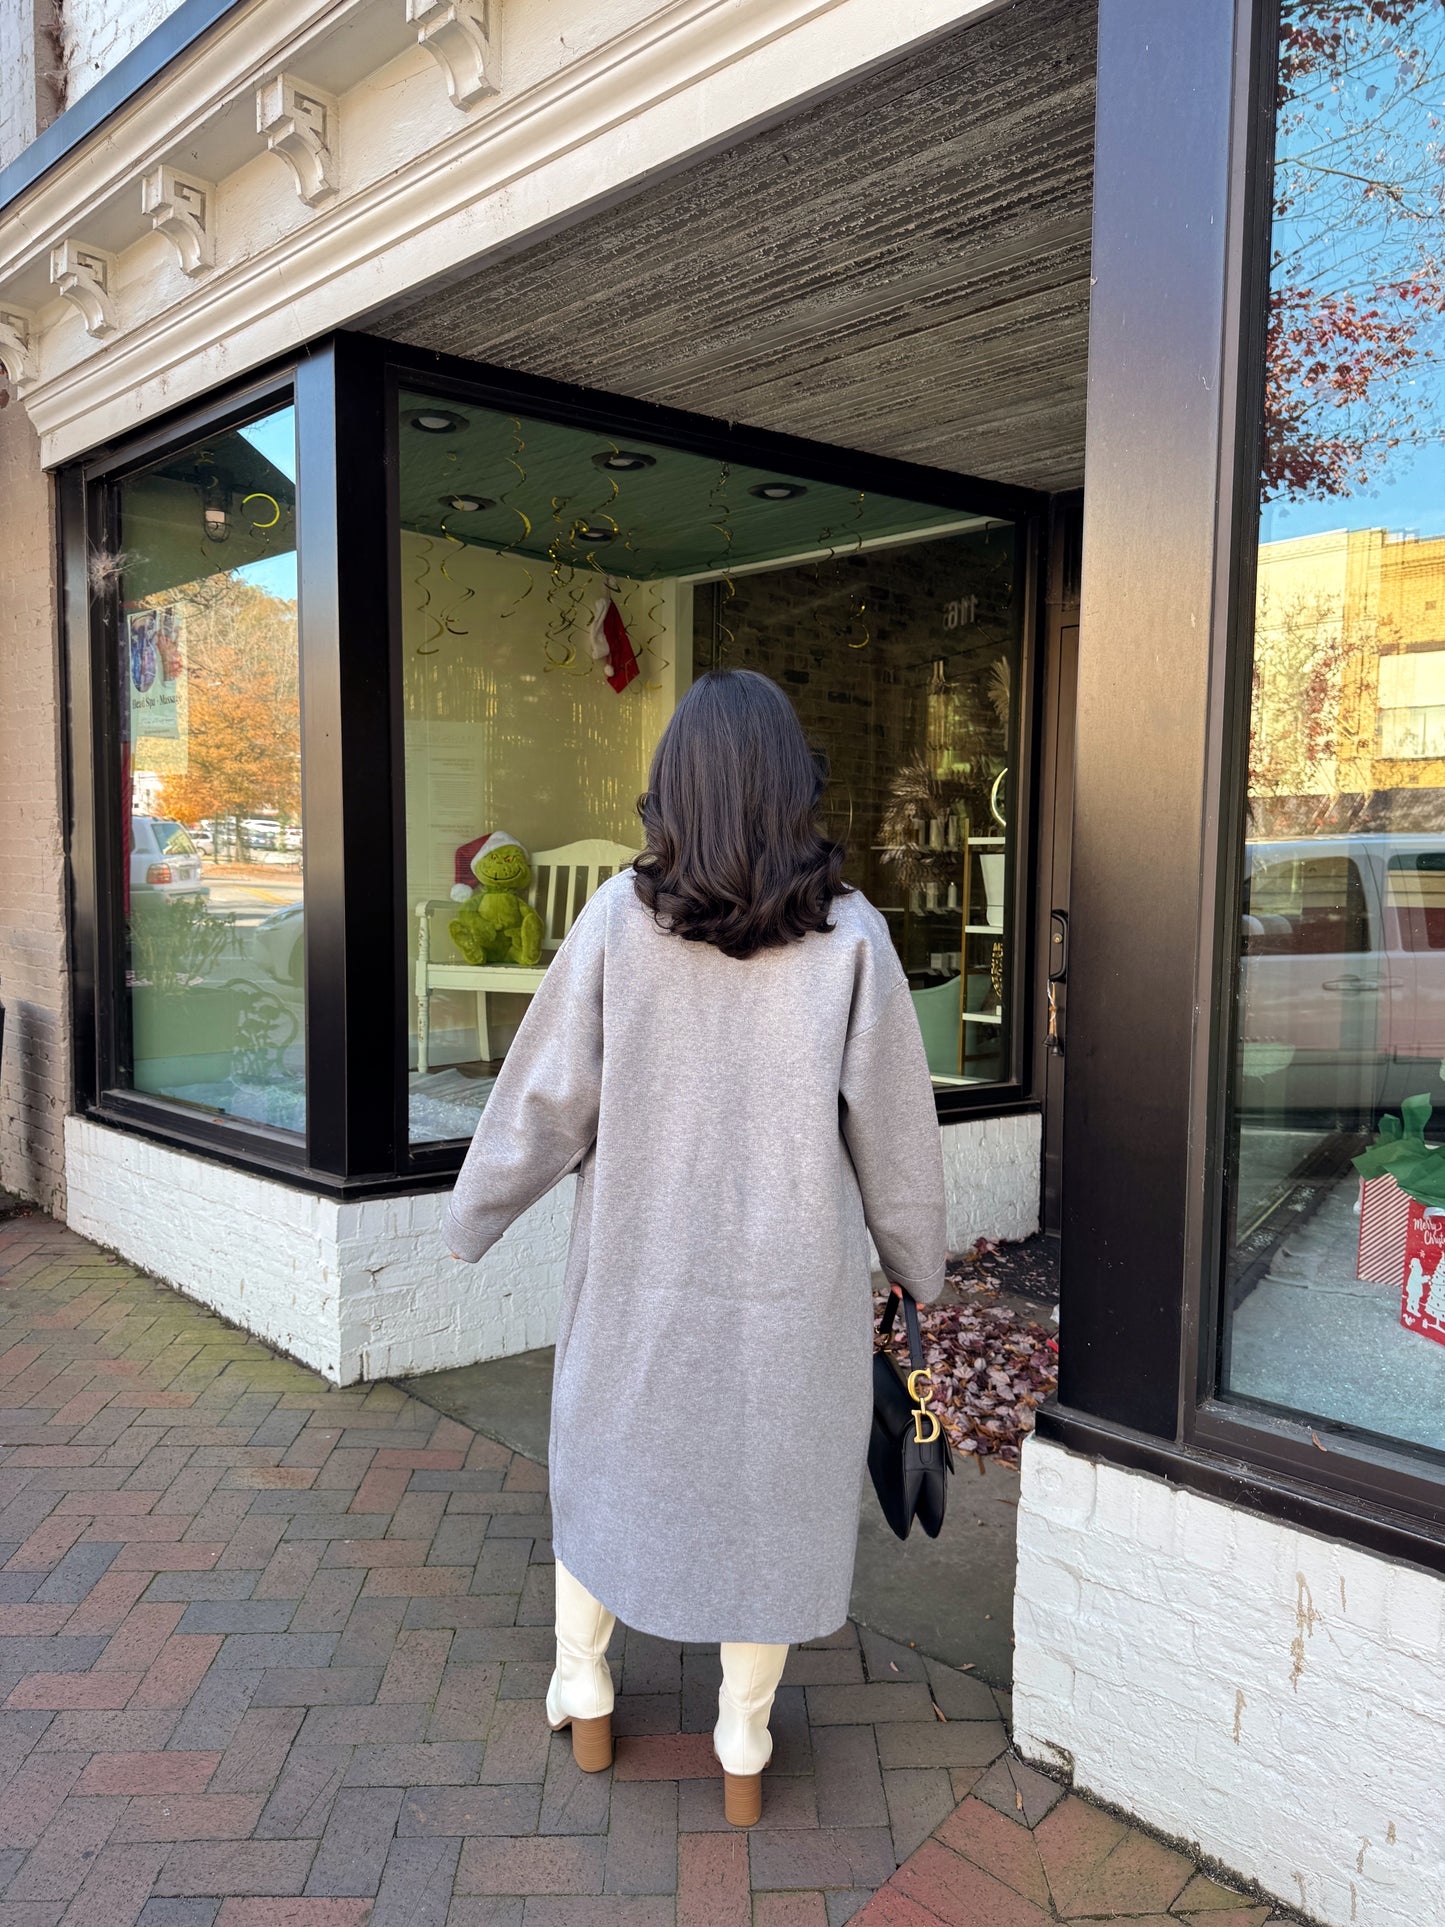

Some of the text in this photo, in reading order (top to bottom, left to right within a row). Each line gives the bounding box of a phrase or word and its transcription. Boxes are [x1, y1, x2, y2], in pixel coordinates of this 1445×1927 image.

[145, 696, 156, 709] Spa
[1413, 1216, 1442, 1232] Merry
[1424, 1229, 1445, 1248] Christ
[907, 1368, 933, 1403] C
[911, 1409, 941, 1443] D
